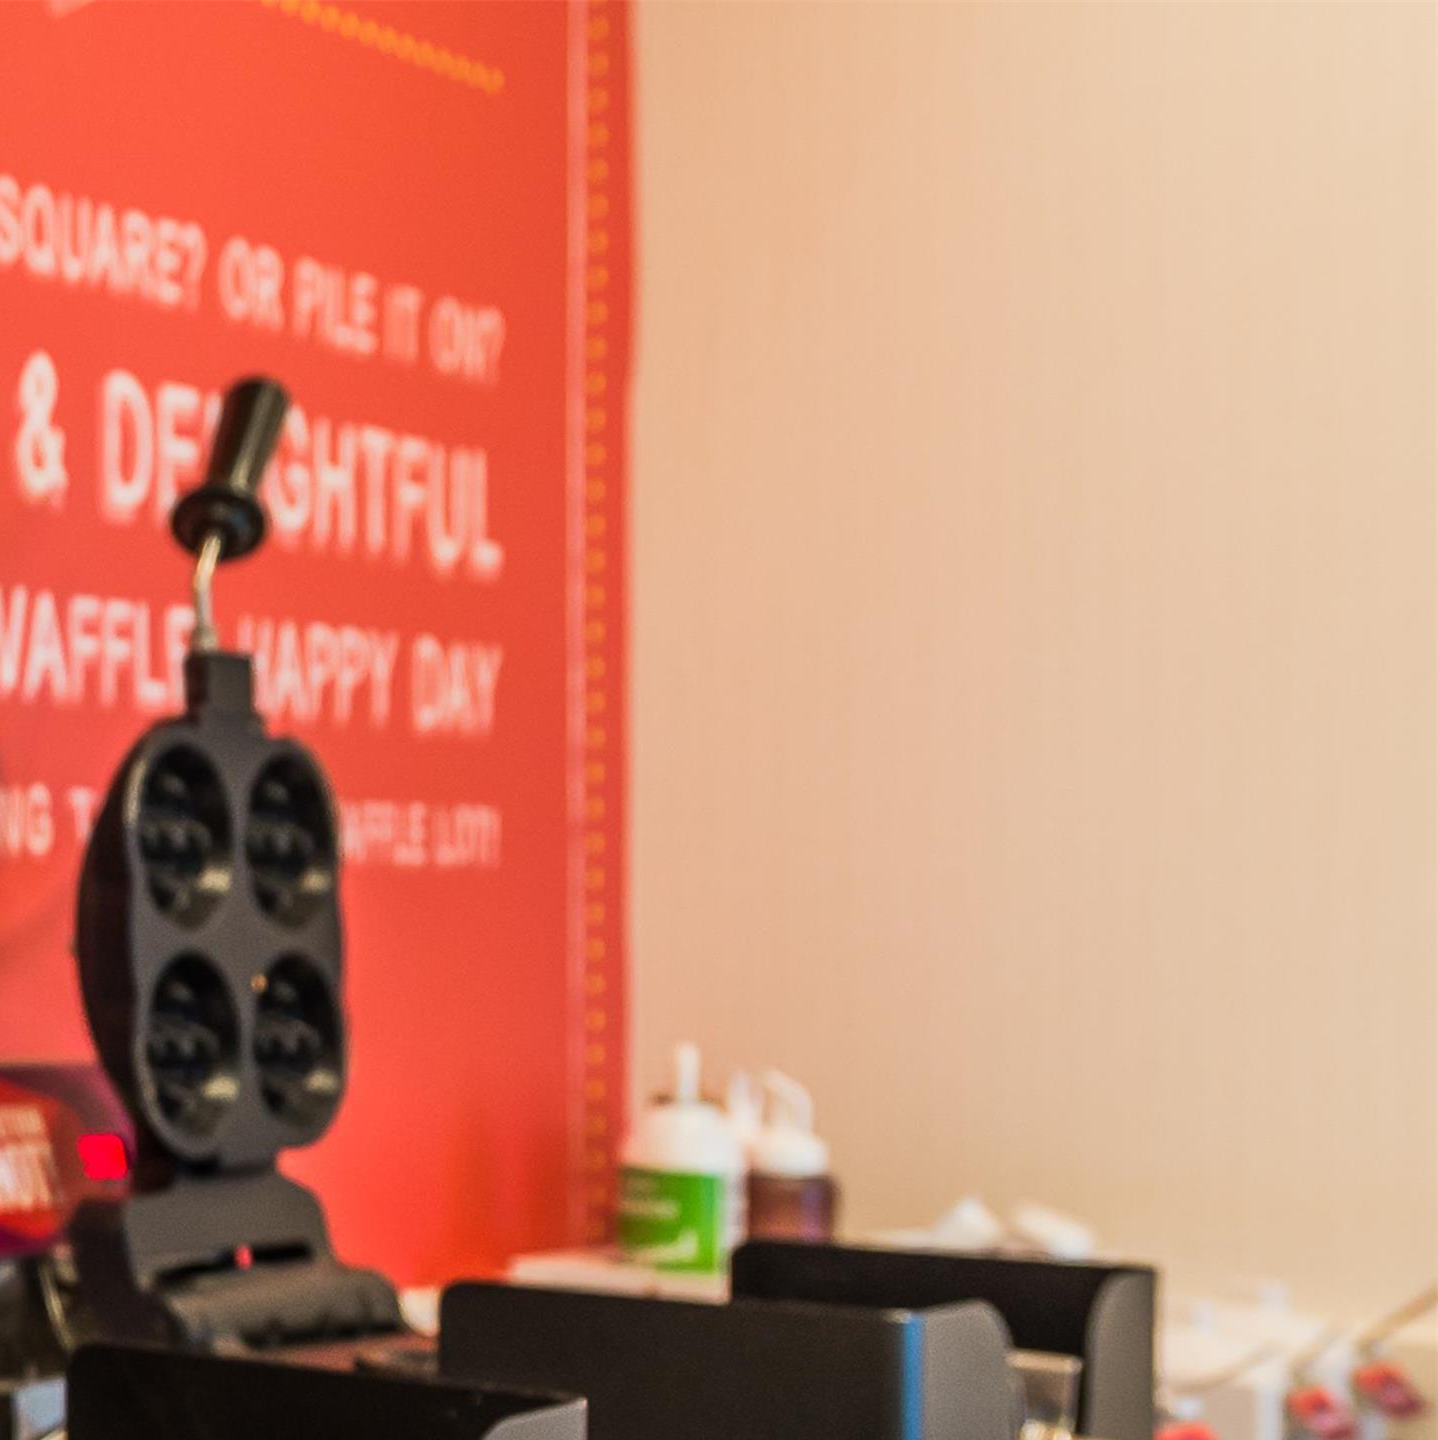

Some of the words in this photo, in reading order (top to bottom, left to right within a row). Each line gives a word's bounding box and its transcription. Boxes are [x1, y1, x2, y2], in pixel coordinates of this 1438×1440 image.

[219, 237, 283, 327] OR
[294, 257, 377, 355] PILE
[14, 352, 68, 503] &
[101, 370, 502, 578] DEGHTFUL
[412, 634, 502, 733] DAY
